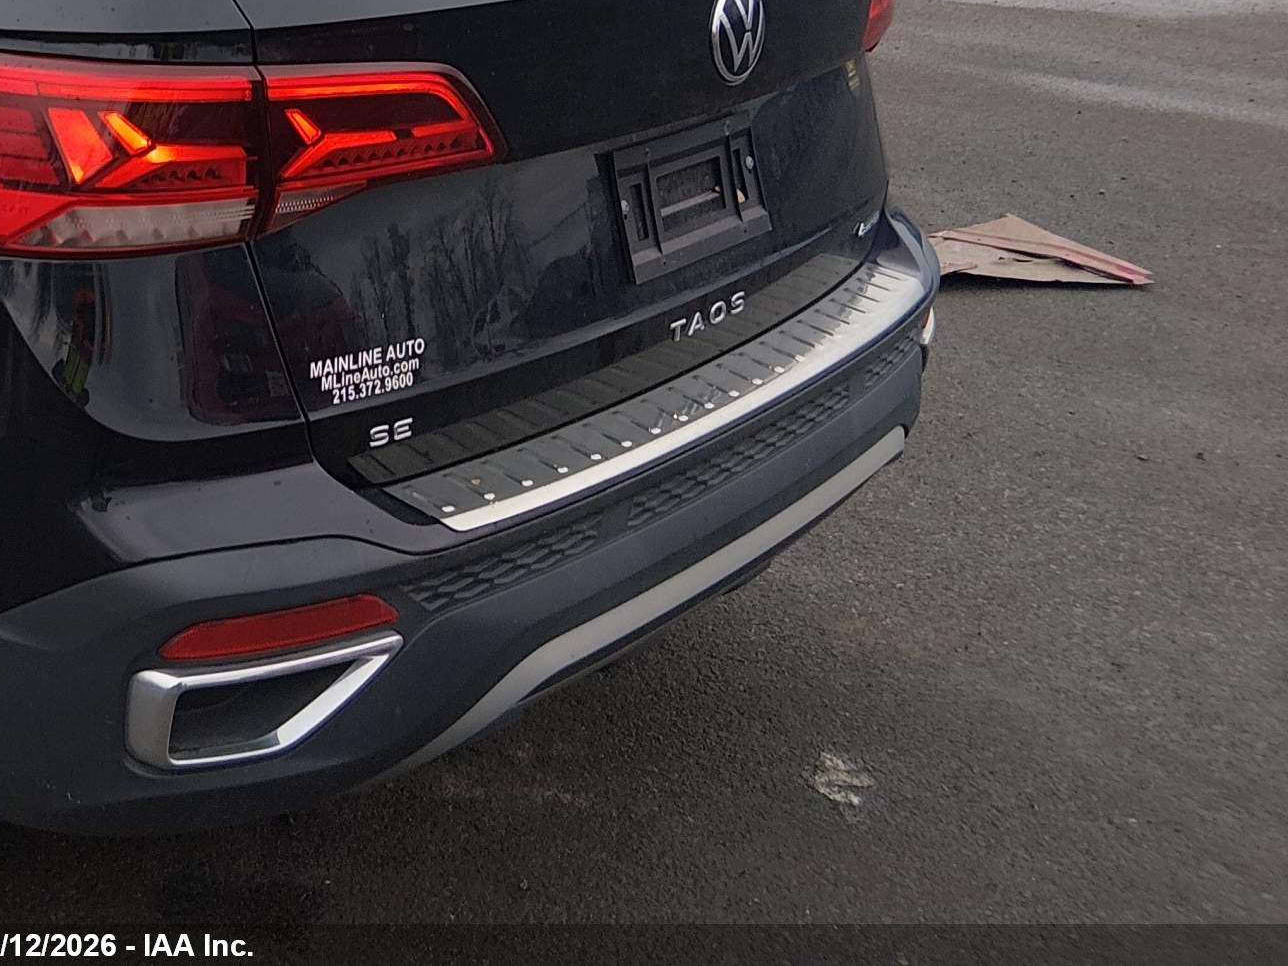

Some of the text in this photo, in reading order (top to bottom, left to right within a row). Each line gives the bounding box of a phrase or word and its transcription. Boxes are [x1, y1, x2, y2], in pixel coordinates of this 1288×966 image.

[669, 290, 745, 342] TAOS
[309, 337, 425, 379] MAINLINE AUTO
[320, 357, 420, 392] MLineAuto.com
[332, 371, 414, 405] 215.372.9600
[368, 417, 414, 447] SE
